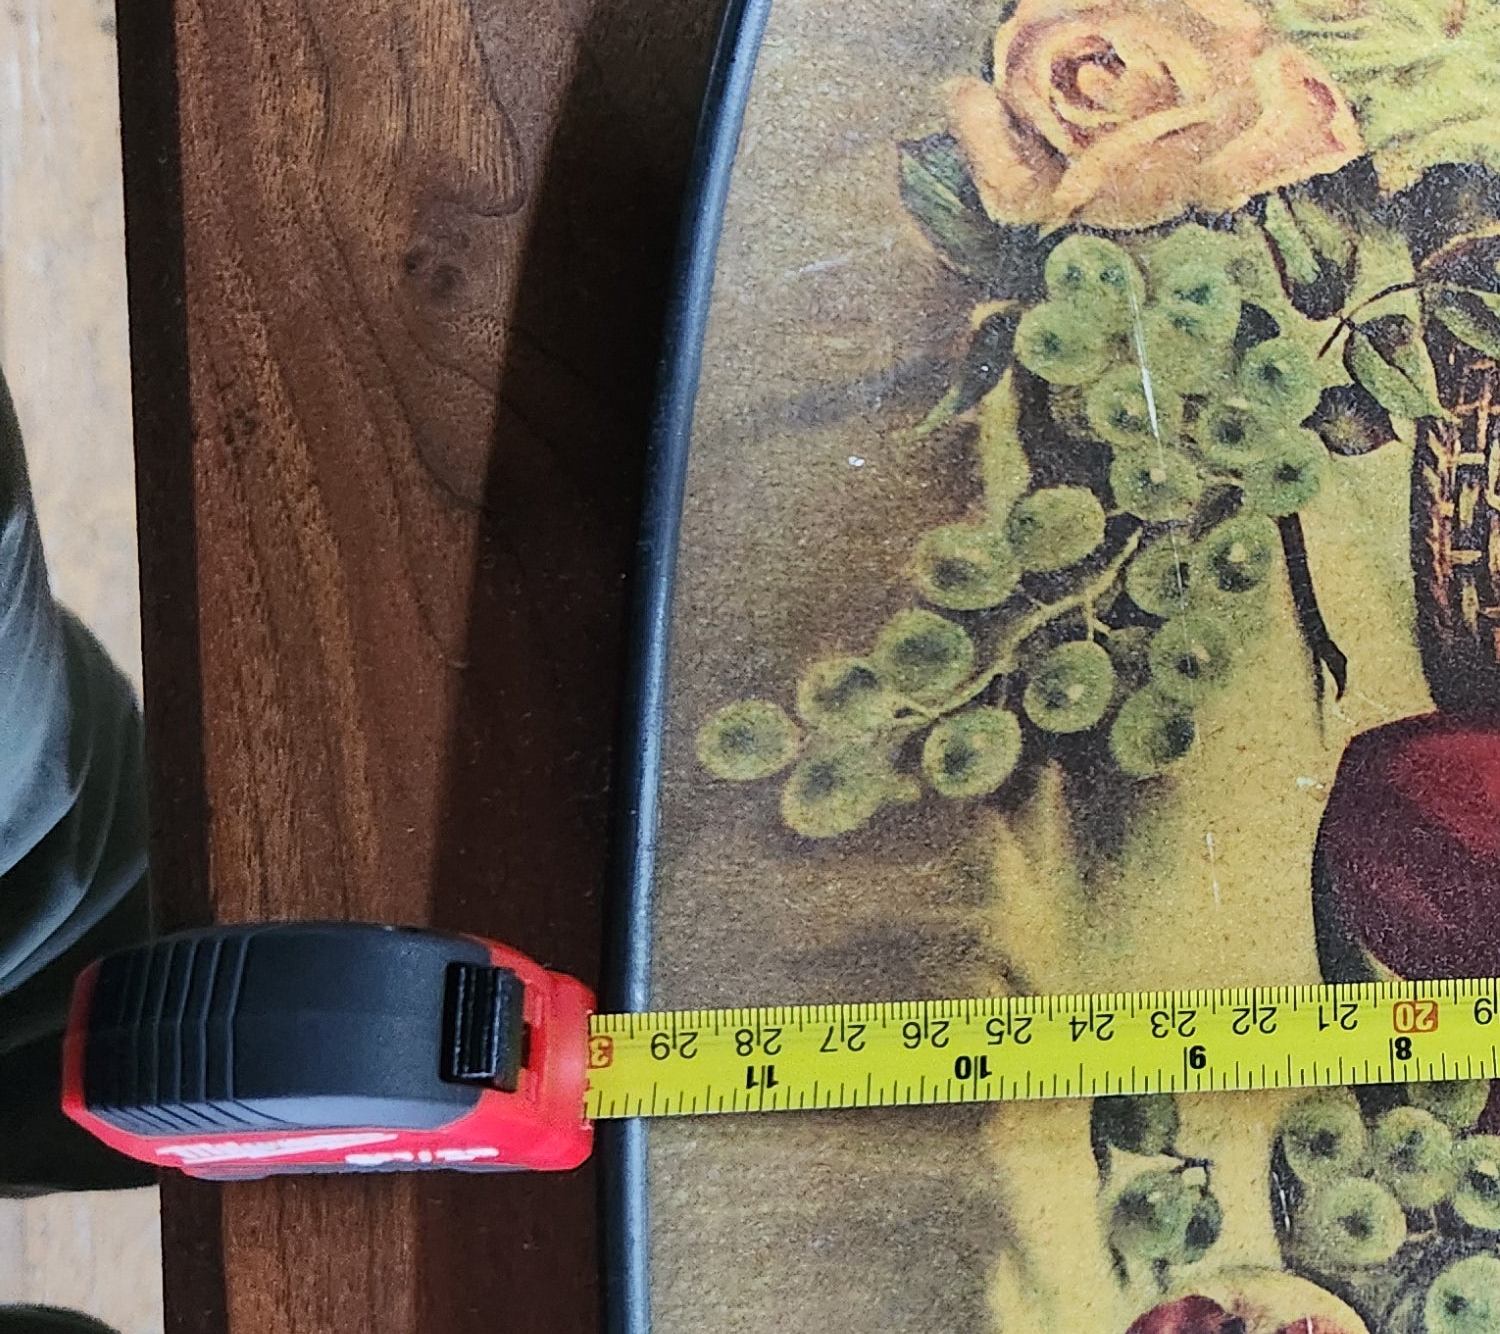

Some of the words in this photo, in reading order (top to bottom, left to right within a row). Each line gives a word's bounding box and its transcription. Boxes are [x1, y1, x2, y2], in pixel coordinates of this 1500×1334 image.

[985, 1016, 1033, 1046] 25
[1068, 1013, 1115, 1043] 24
[1149, 1009, 1197, 1039] 23
[1231, 1006, 1278, 1036] 22
[1317, 1003, 1359, 1033] 21
[1395, 1001, 1436, 1032] 20
[651, 1030, 699, 1061] 29
[734, 1027, 783, 1057] 28
[819, 1024, 867, 1054] 27
[901, 1020, 951, 1050] 26
[1393, 1036, 1413, 1061] 8
[953, 1054, 993, 1081] 10
[1188, 1044, 1207, 1070] 9
[744, 1064, 780, 1090] 11
